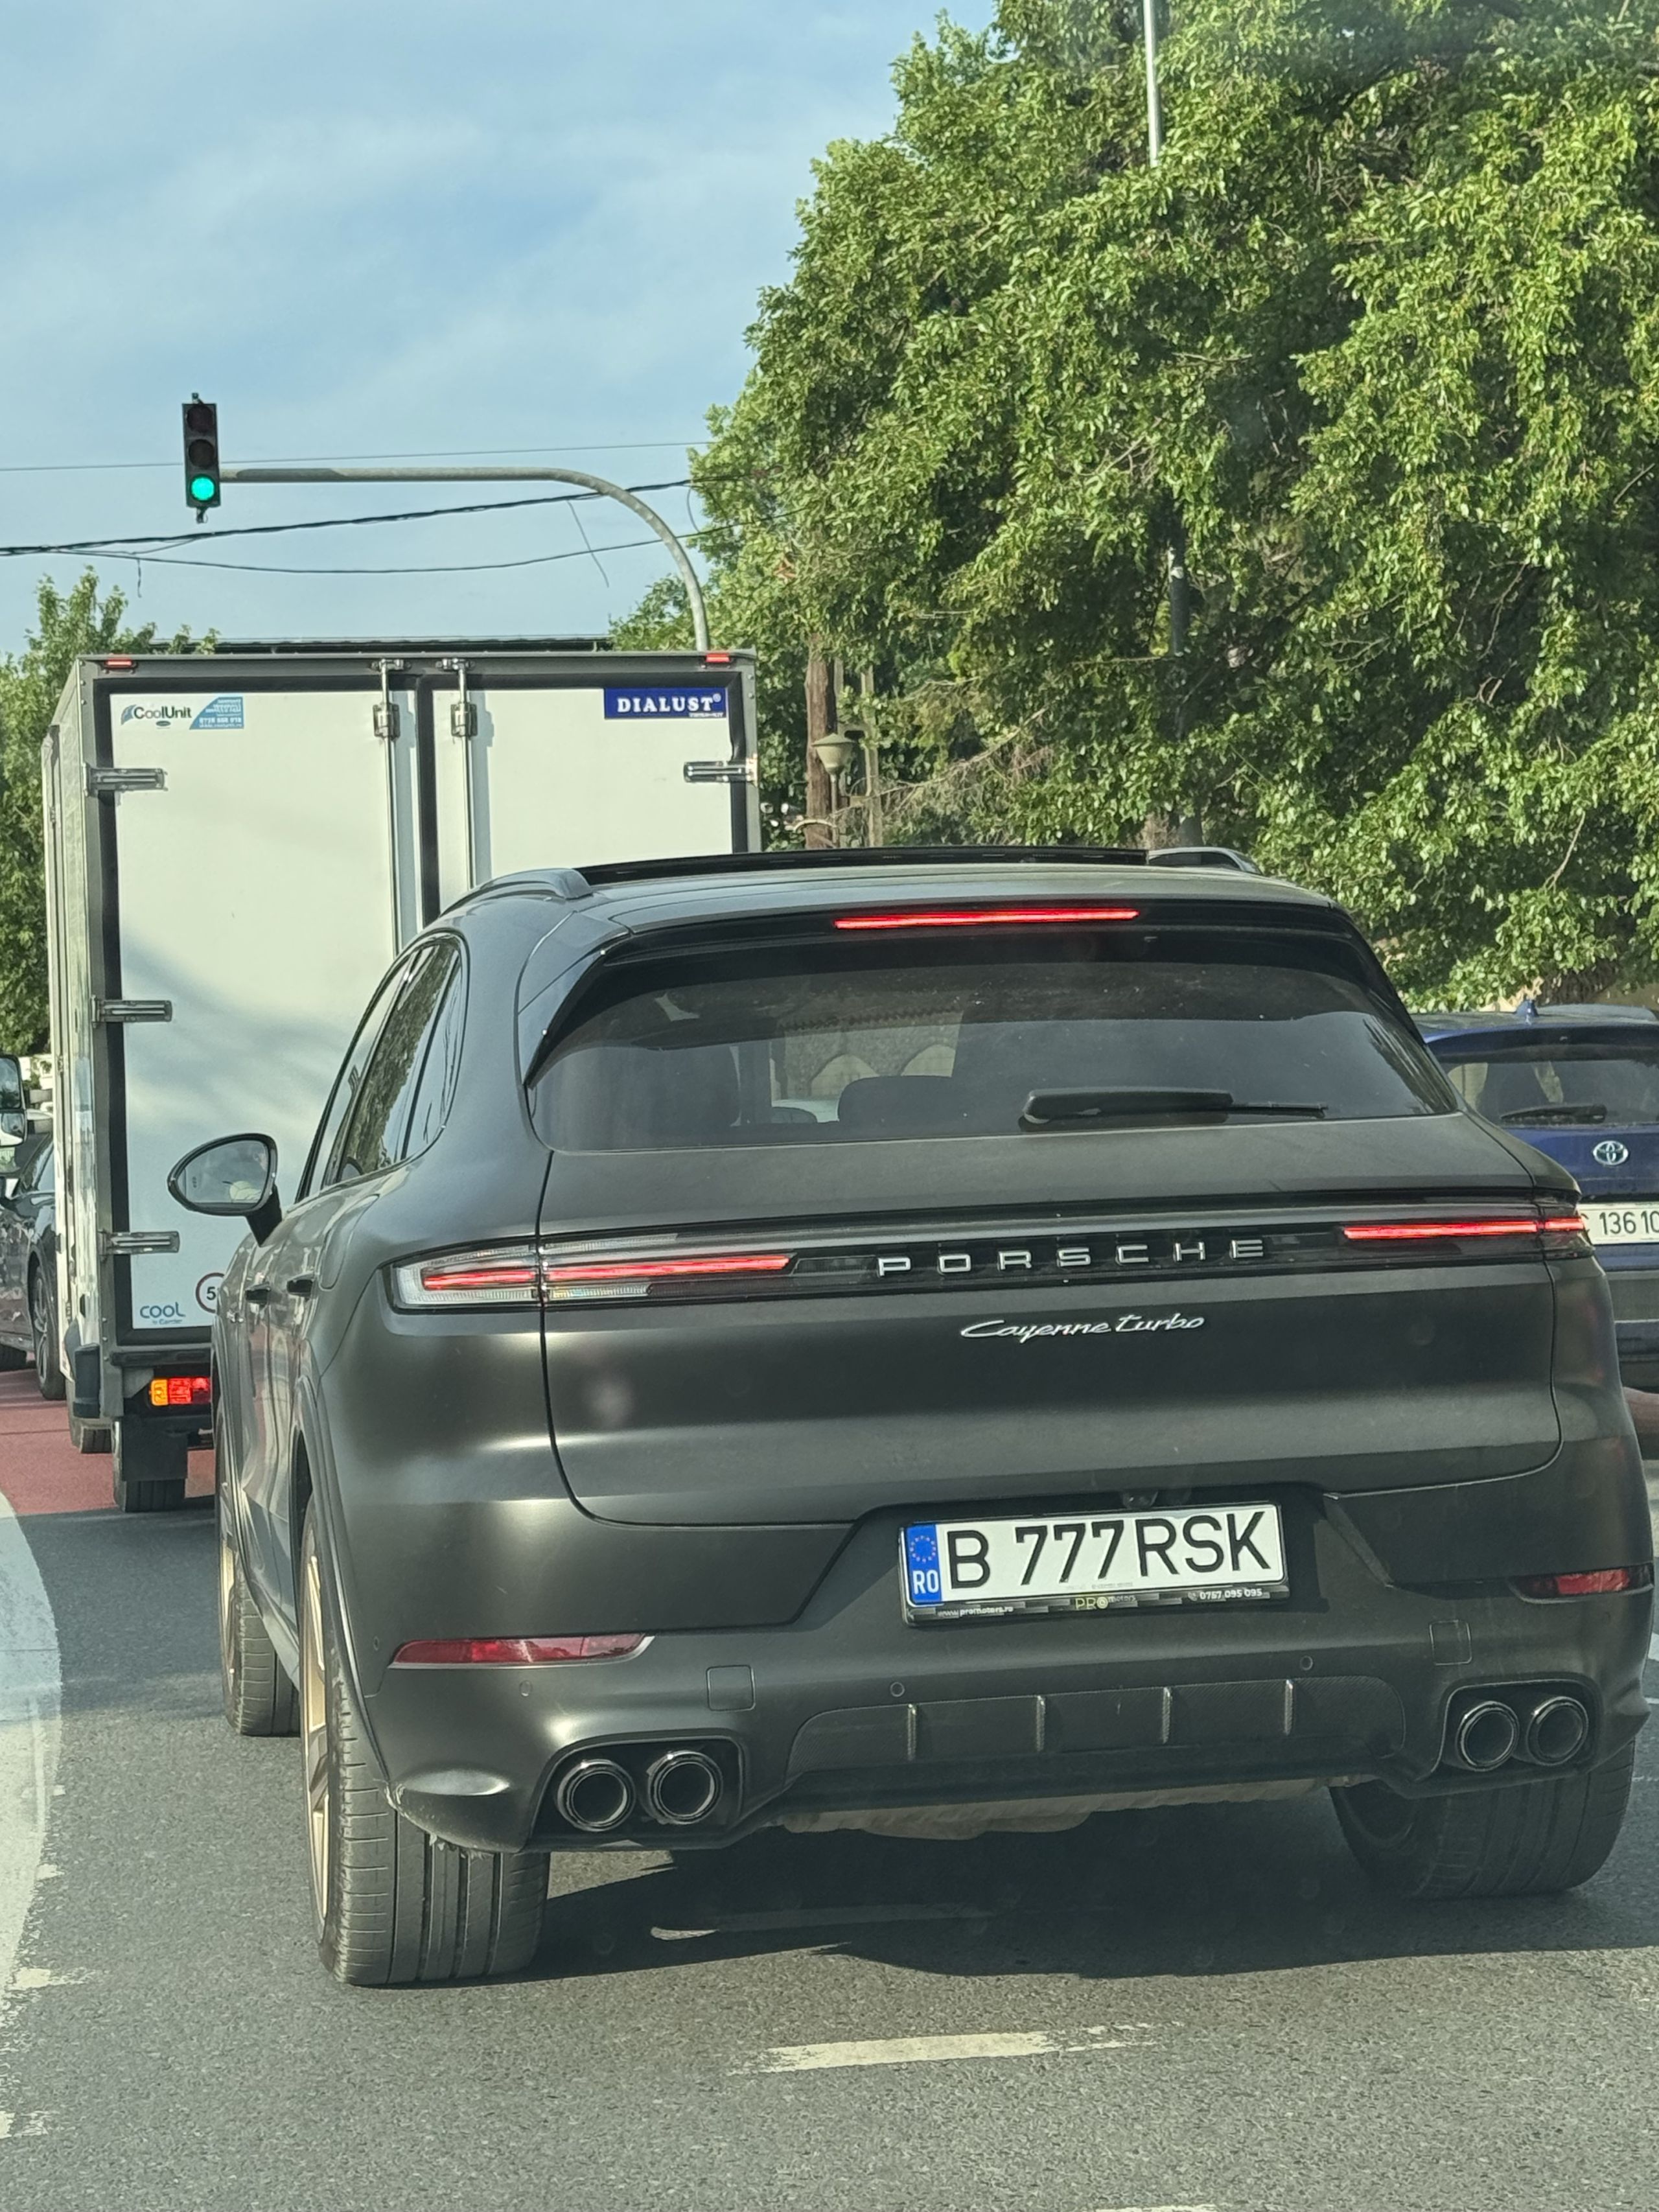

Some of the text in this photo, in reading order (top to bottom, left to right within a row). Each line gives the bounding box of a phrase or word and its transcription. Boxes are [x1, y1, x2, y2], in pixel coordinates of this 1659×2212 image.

[133, 706, 192, 719] CoolUnit
[617, 696, 713, 713] DIALUST
[877, 1239, 1264, 1277] PORSCHE
[206, 1286, 216, 1301] 5
[960, 1312, 1206, 1344] Cayenne turbo
[946, 1530, 991, 1590] B
[912, 1569, 939, 1595] RO
[1224, 1589, 1243, 1599] 095
[1244, 1587, 1263, 1598] 095
